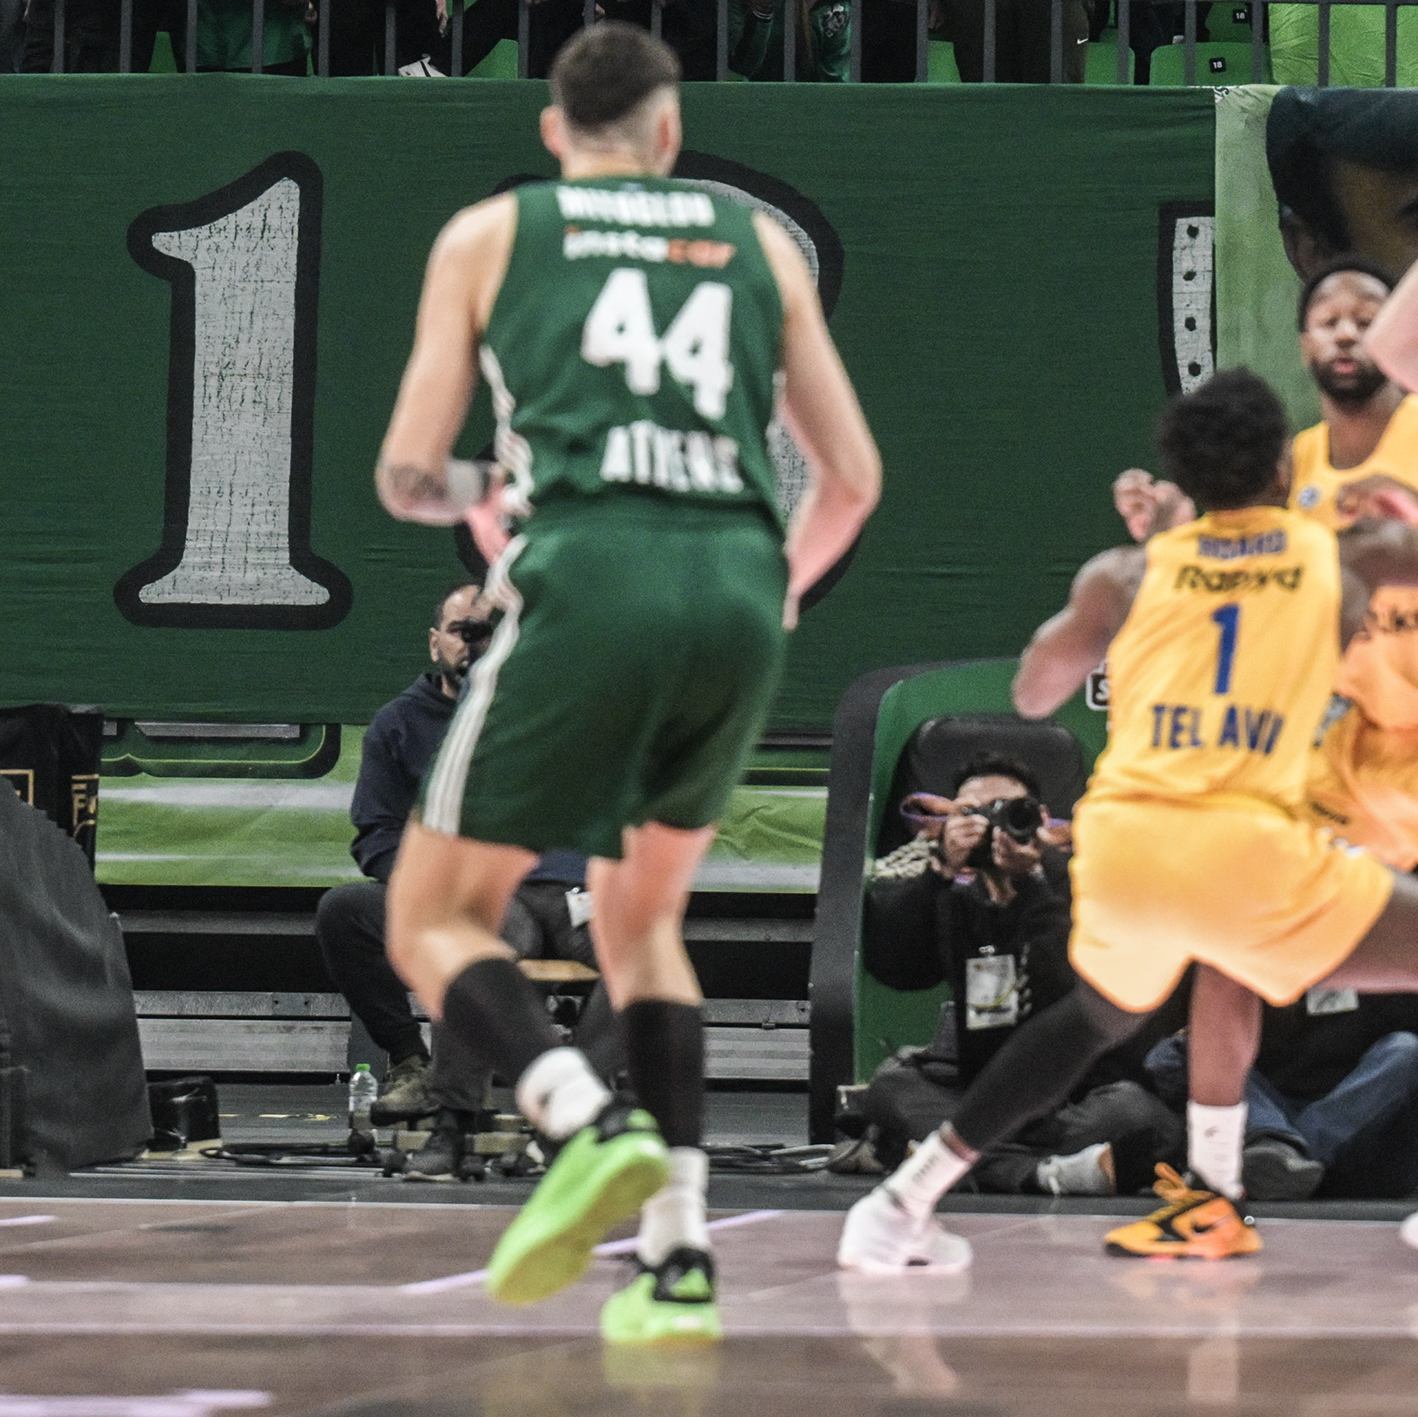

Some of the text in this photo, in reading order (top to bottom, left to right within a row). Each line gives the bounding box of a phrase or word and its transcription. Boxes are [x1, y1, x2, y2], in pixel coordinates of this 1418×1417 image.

[583, 266, 734, 420] 44
[1212, 603, 1241, 695] 1
[1150, 702, 1205, 751] TEL
